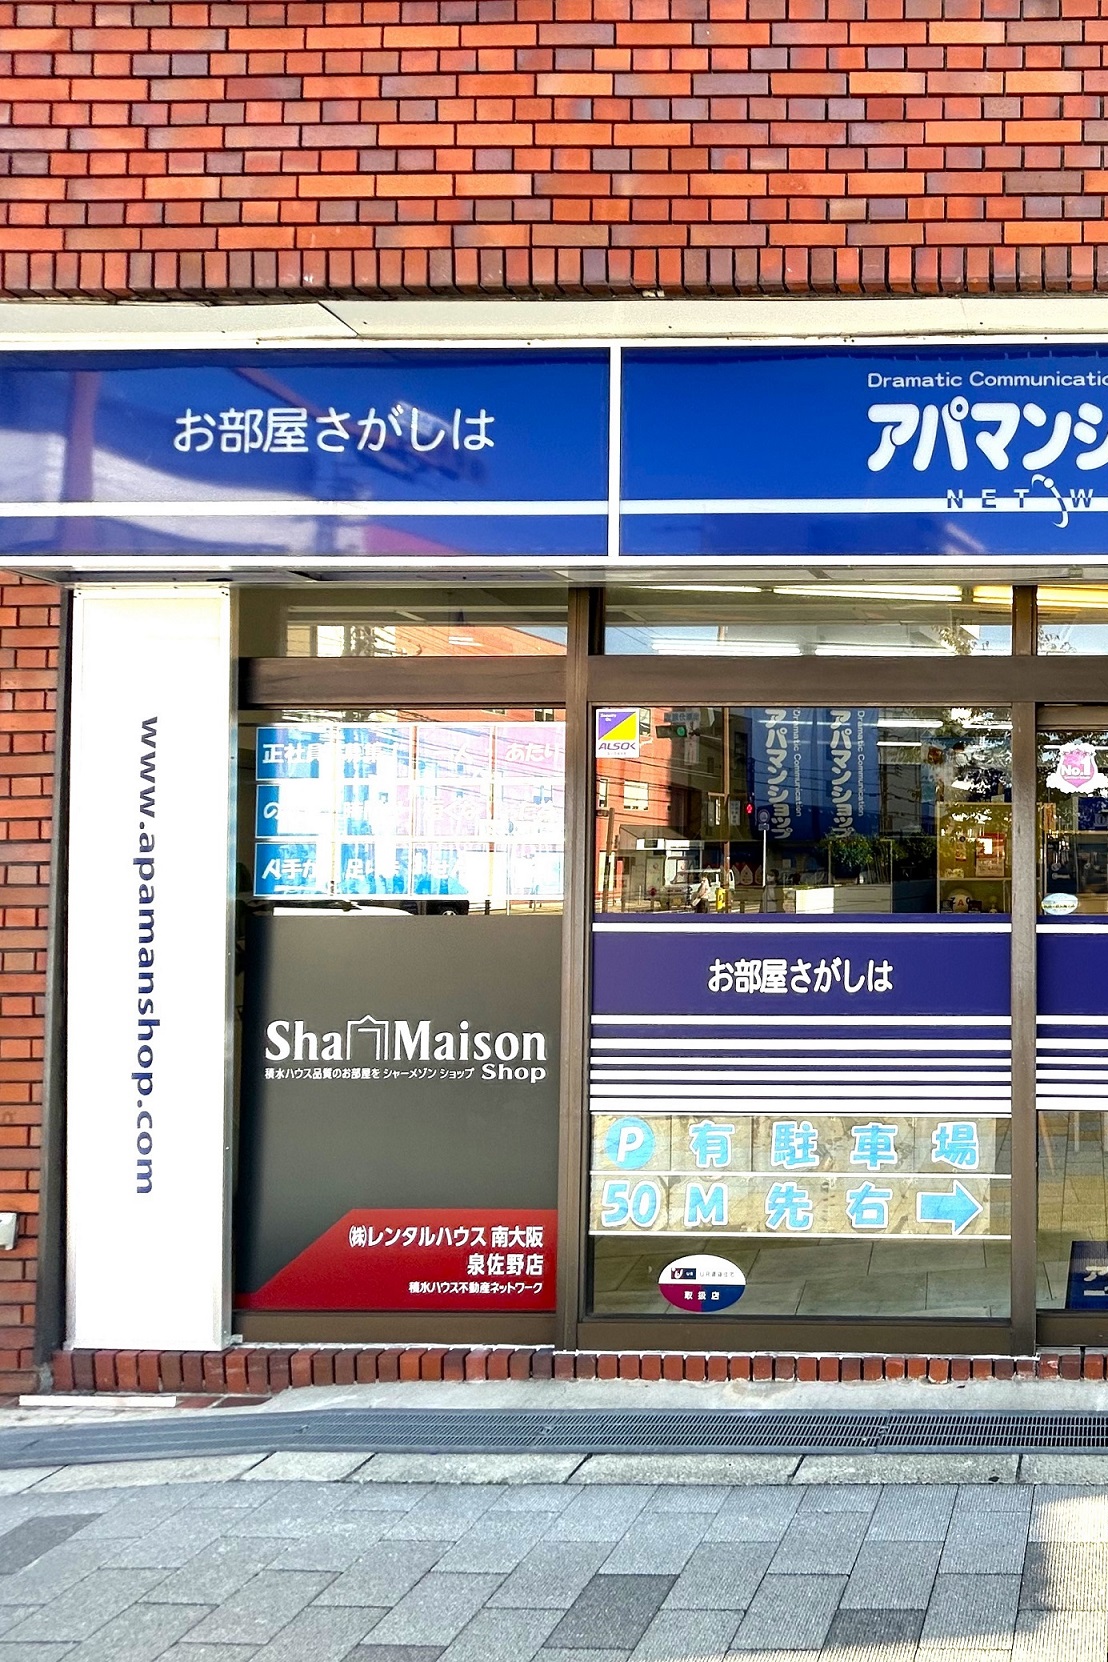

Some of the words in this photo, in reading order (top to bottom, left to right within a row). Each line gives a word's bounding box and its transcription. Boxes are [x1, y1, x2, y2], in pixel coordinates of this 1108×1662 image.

[868, 373, 963, 389] Dramatic
[173, 405, 496, 454] お部屋さがしは
[598, 742, 636, 750] ALSOK
[132, 716, 161, 1194] www.apamanshop.com
[708, 957, 894, 995] お部屋さがしは
[265, 1020, 342, 1061] Sha
[395, 1020, 548, 1061] Maison
[481, 1063, 548, 1084] Shop
[491, 1226, 545, 1249] 南大阪
[467, 1253, 545, 1277] 泉佐野店
[408, 1281, 544, 1295] 積水ハウス不動産ネットワーク
